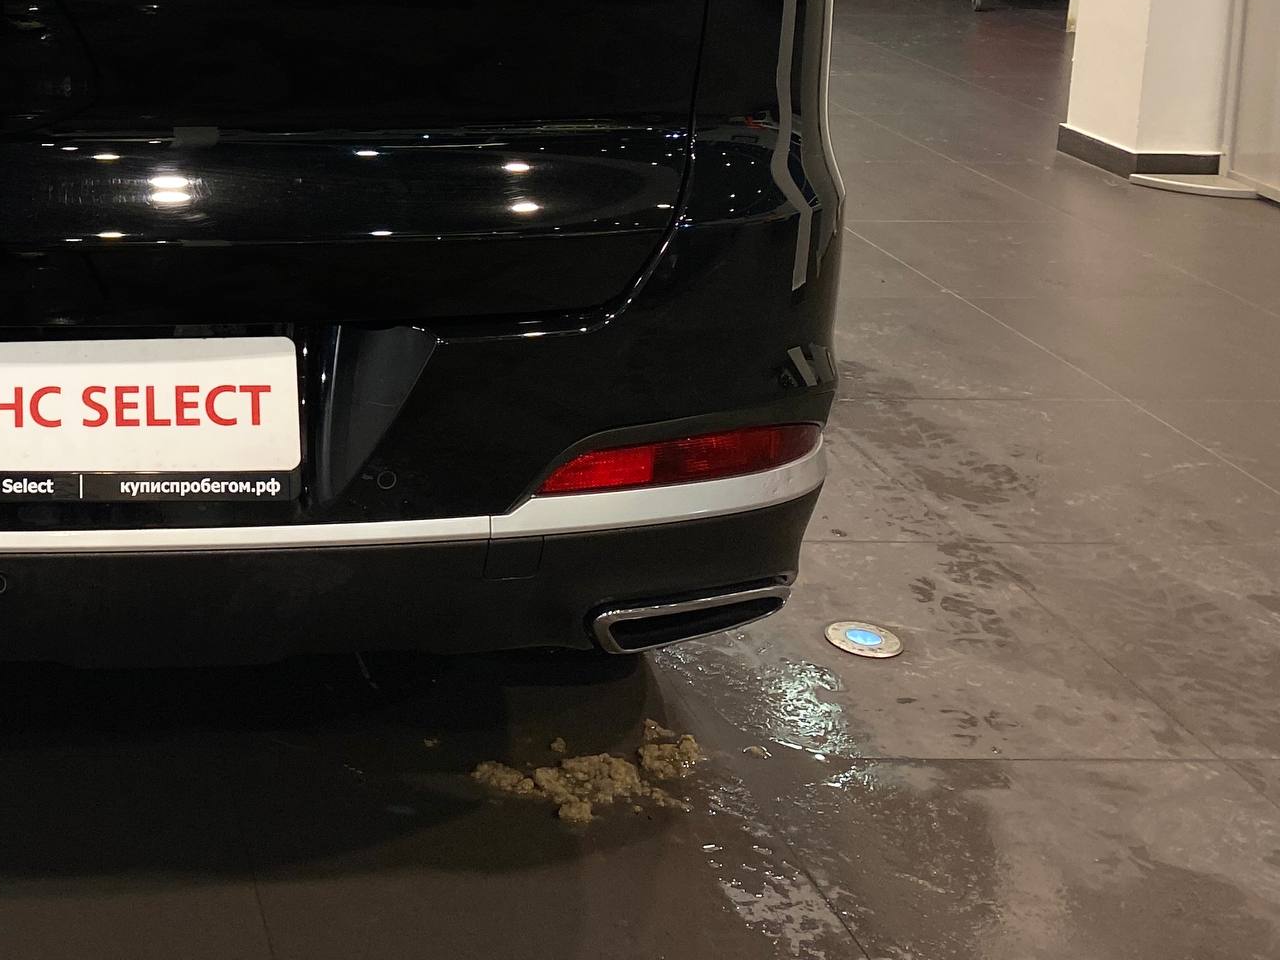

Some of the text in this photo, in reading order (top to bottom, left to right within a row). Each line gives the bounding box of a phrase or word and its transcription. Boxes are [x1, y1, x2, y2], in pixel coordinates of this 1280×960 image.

[81, 385, 271, 427] SELECT
[1, 477, 55, 494] Select
[119, 477, 281, 497] куписпробегом.рф
